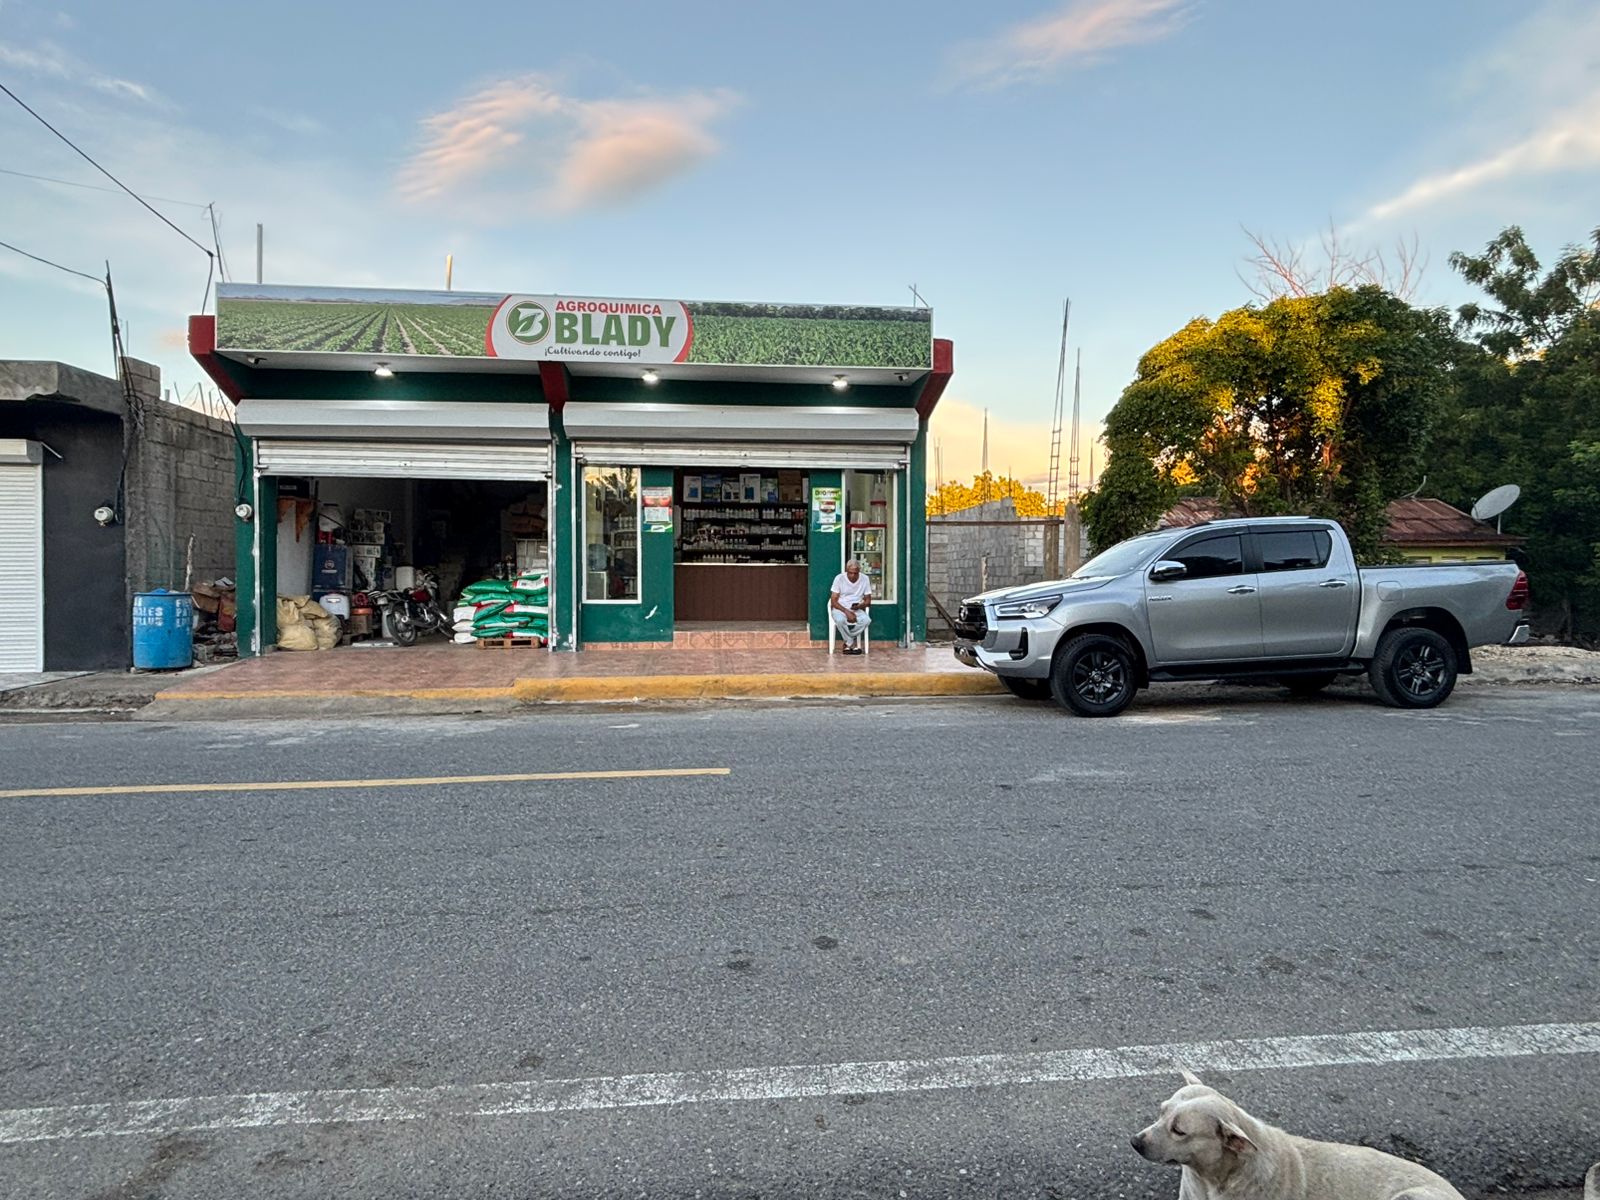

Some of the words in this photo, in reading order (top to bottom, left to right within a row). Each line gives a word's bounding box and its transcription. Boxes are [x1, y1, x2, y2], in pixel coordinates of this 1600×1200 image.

[555, 300, 662, 315] AGROQUIMICA
[555, 312, 677, 348] BLADY
[544, 345, 601, 357] ¡Cultivando
[603, 348, 641, 360] contigo!
